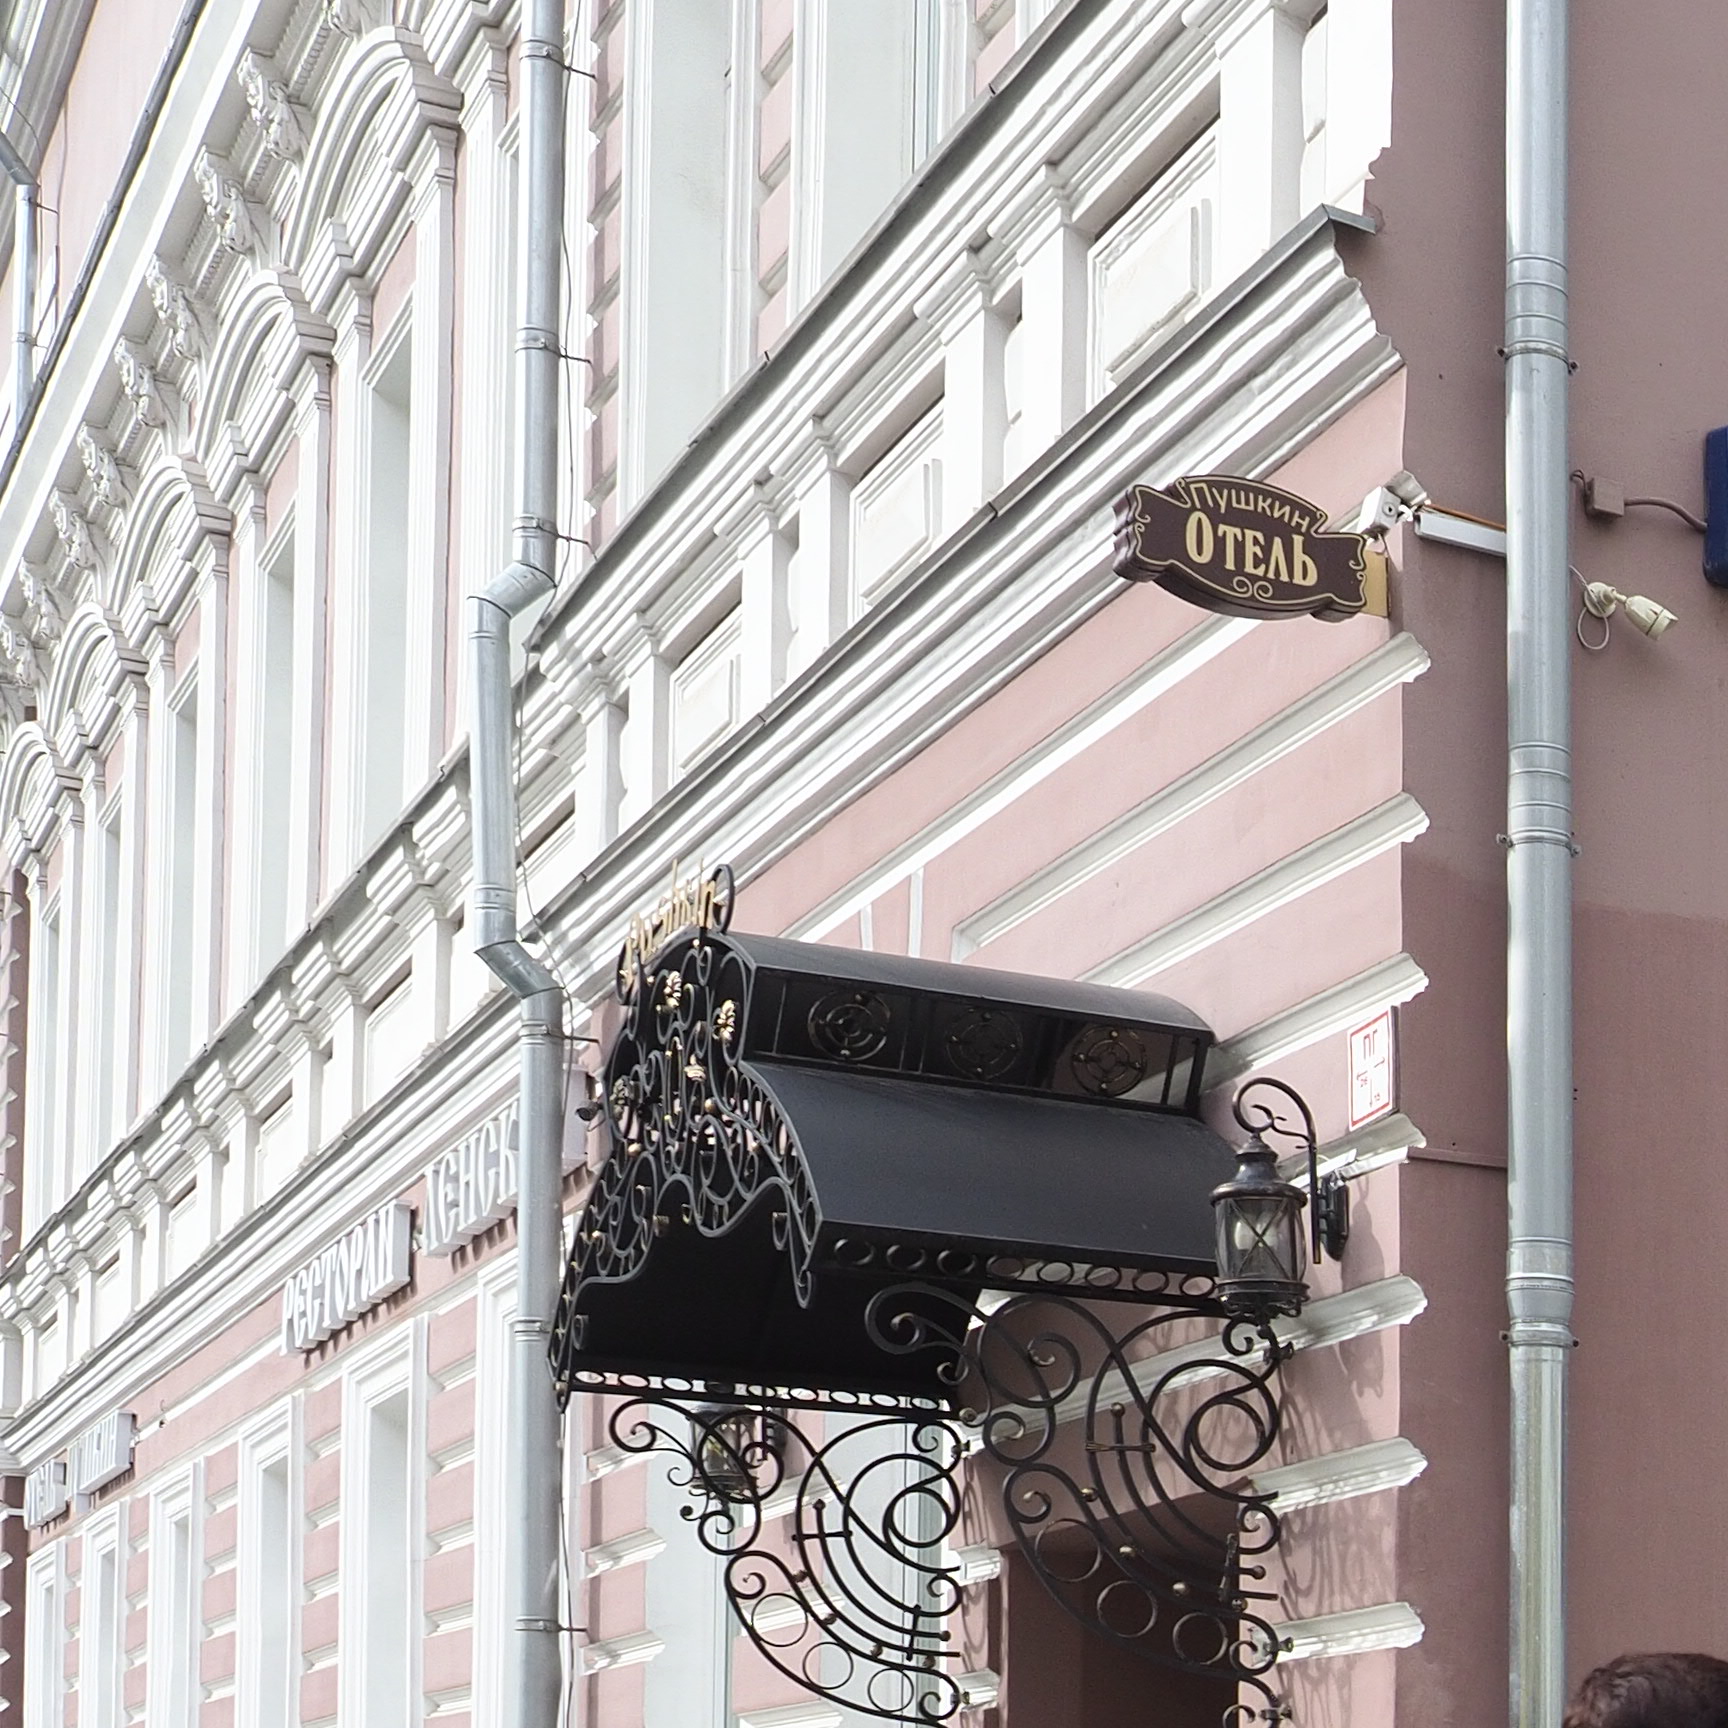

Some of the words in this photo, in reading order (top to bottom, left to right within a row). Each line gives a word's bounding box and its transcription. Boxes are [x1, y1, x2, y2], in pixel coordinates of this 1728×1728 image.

[1188, 482, 1311, 534] Пушкин
[1184, 510, 1319, 587] ОТЕЛЬ
[280, 1199, 404, 1357] РЕСТОРАН
